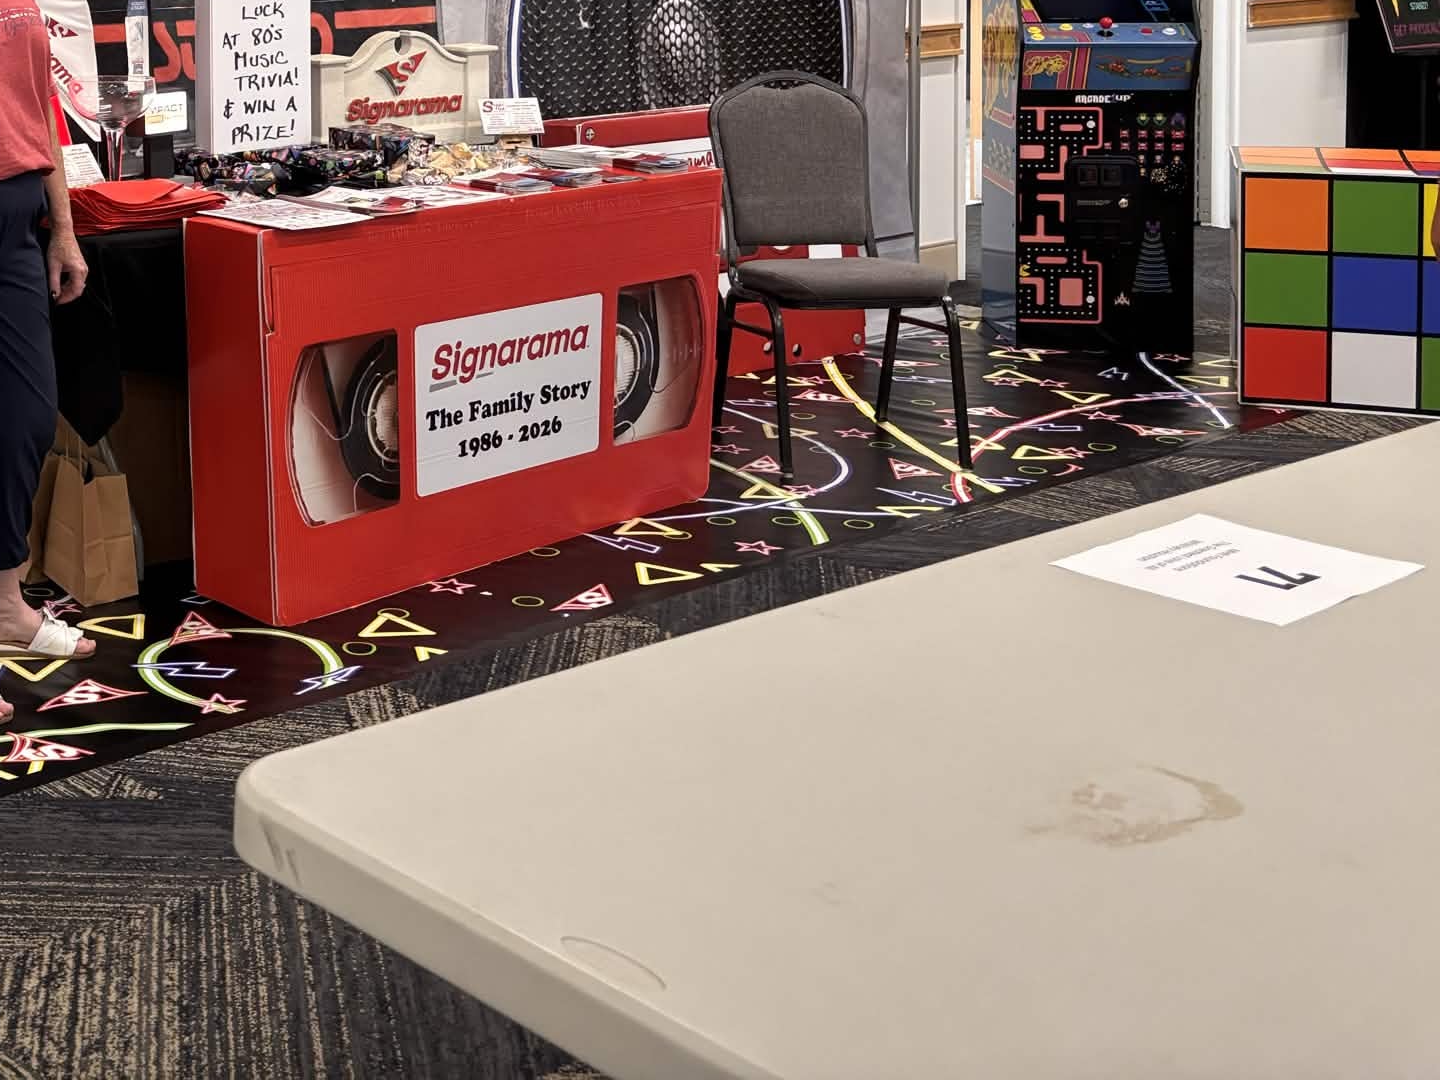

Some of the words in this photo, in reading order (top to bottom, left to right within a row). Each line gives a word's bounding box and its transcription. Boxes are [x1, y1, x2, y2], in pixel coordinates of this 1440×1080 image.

[242, 2, 285, 20] LUCK
[222, 32, 241, 50] AT
[234, 51, 289, 70] MUSIC
[234, 66, 300, 92] TRIVIA!
[243, 98, 275, 115] WIN
[285, 95, 297, 112] A
[345, 94, 463, 124] Signarama
[231, 118, 295, 146] PRIZE!
[432, 324, 589, 384] Signarama
[426, 408, 463, 431] The
[469, 391, 535, 422] Family
[540, 380, 592, 405] Story
[458, 430, 503, 458] 1986
[518, 415, 563, 443] 2026
